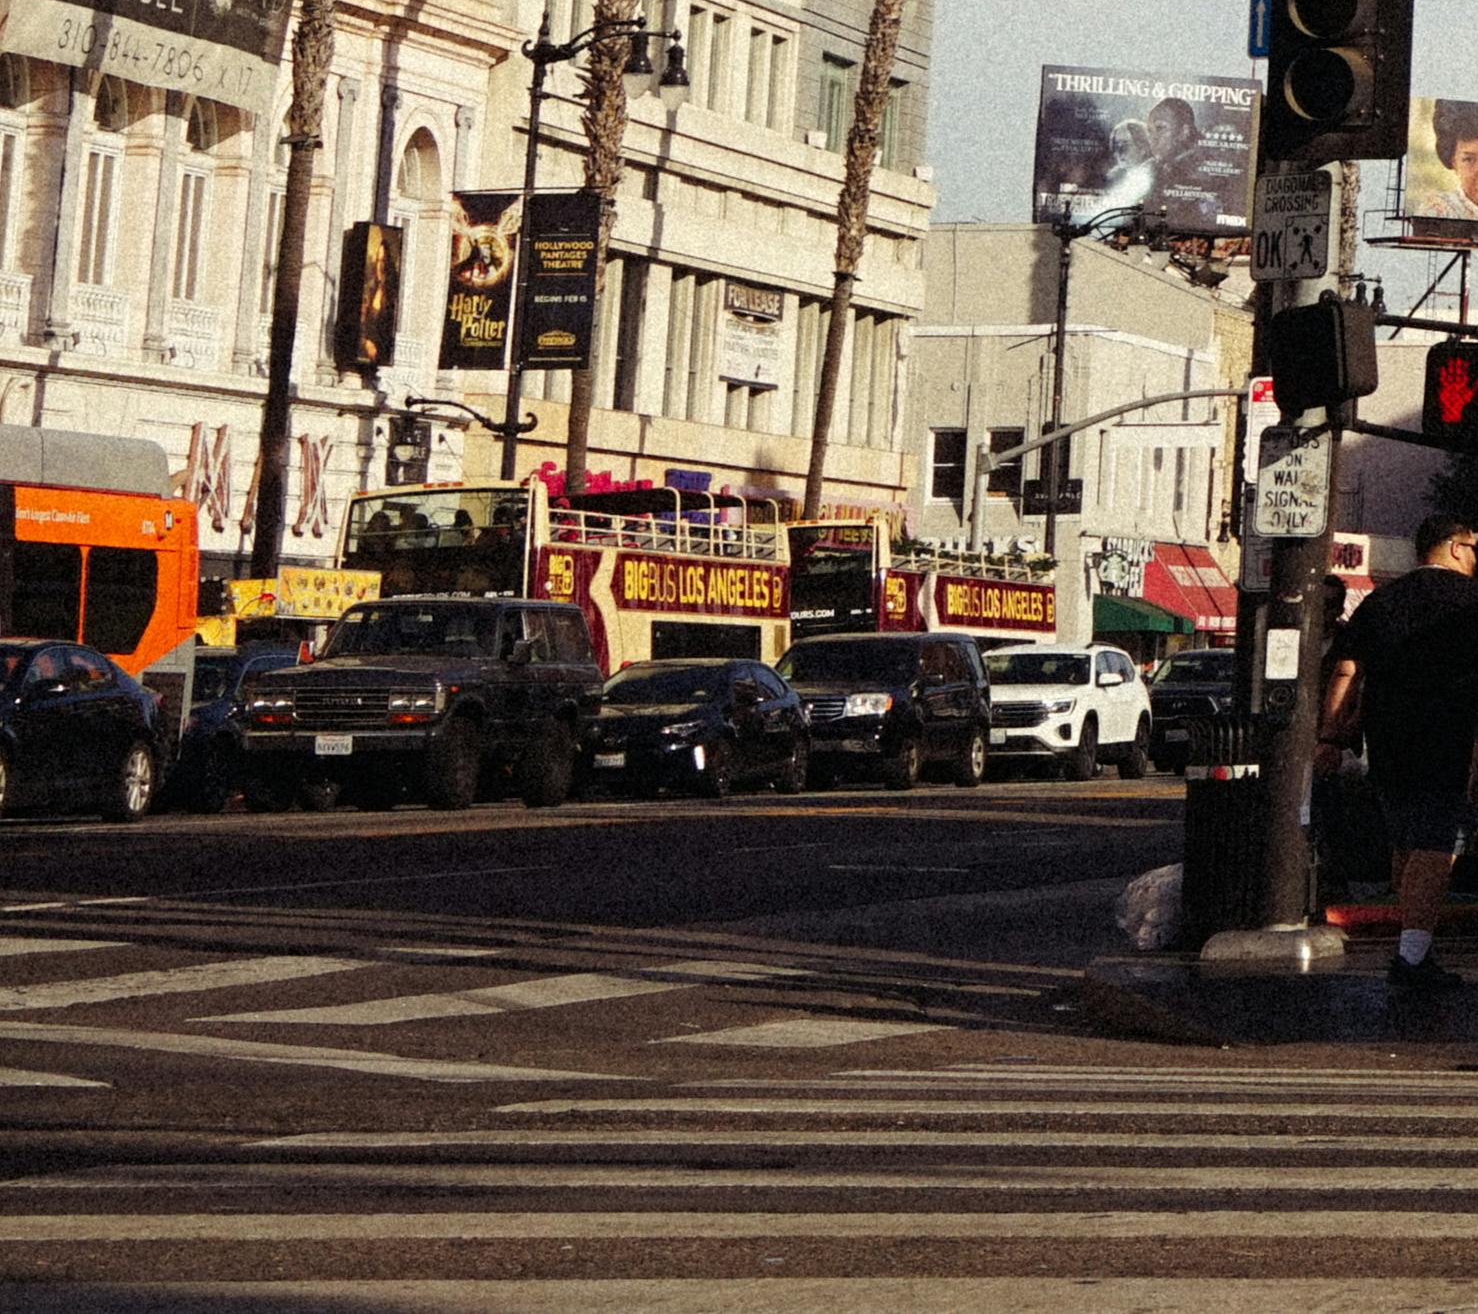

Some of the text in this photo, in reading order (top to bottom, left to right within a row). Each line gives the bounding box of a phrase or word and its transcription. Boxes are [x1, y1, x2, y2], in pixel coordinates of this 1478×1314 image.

[58, 19, 204, 82] 310-844-7806
[1151, 82, 1166, 98] &
[1265, 194, 1319, 213] CROSSING
[534, 241, 594, 250] HOLLYWOOD
[540, 251, 588, 260] PANTAGES
[1256, 231, 1283, 269] OK
[543, 260, 584, 269] THEATRE
[460, 314, 505, 343] Potter
[679, 566, 705, 605] LOS
[708, 568, 770, 608] ANGELES
[981, 589, 1000, 619] LOS
[1001, 589, 1044, 621] ANGELES
